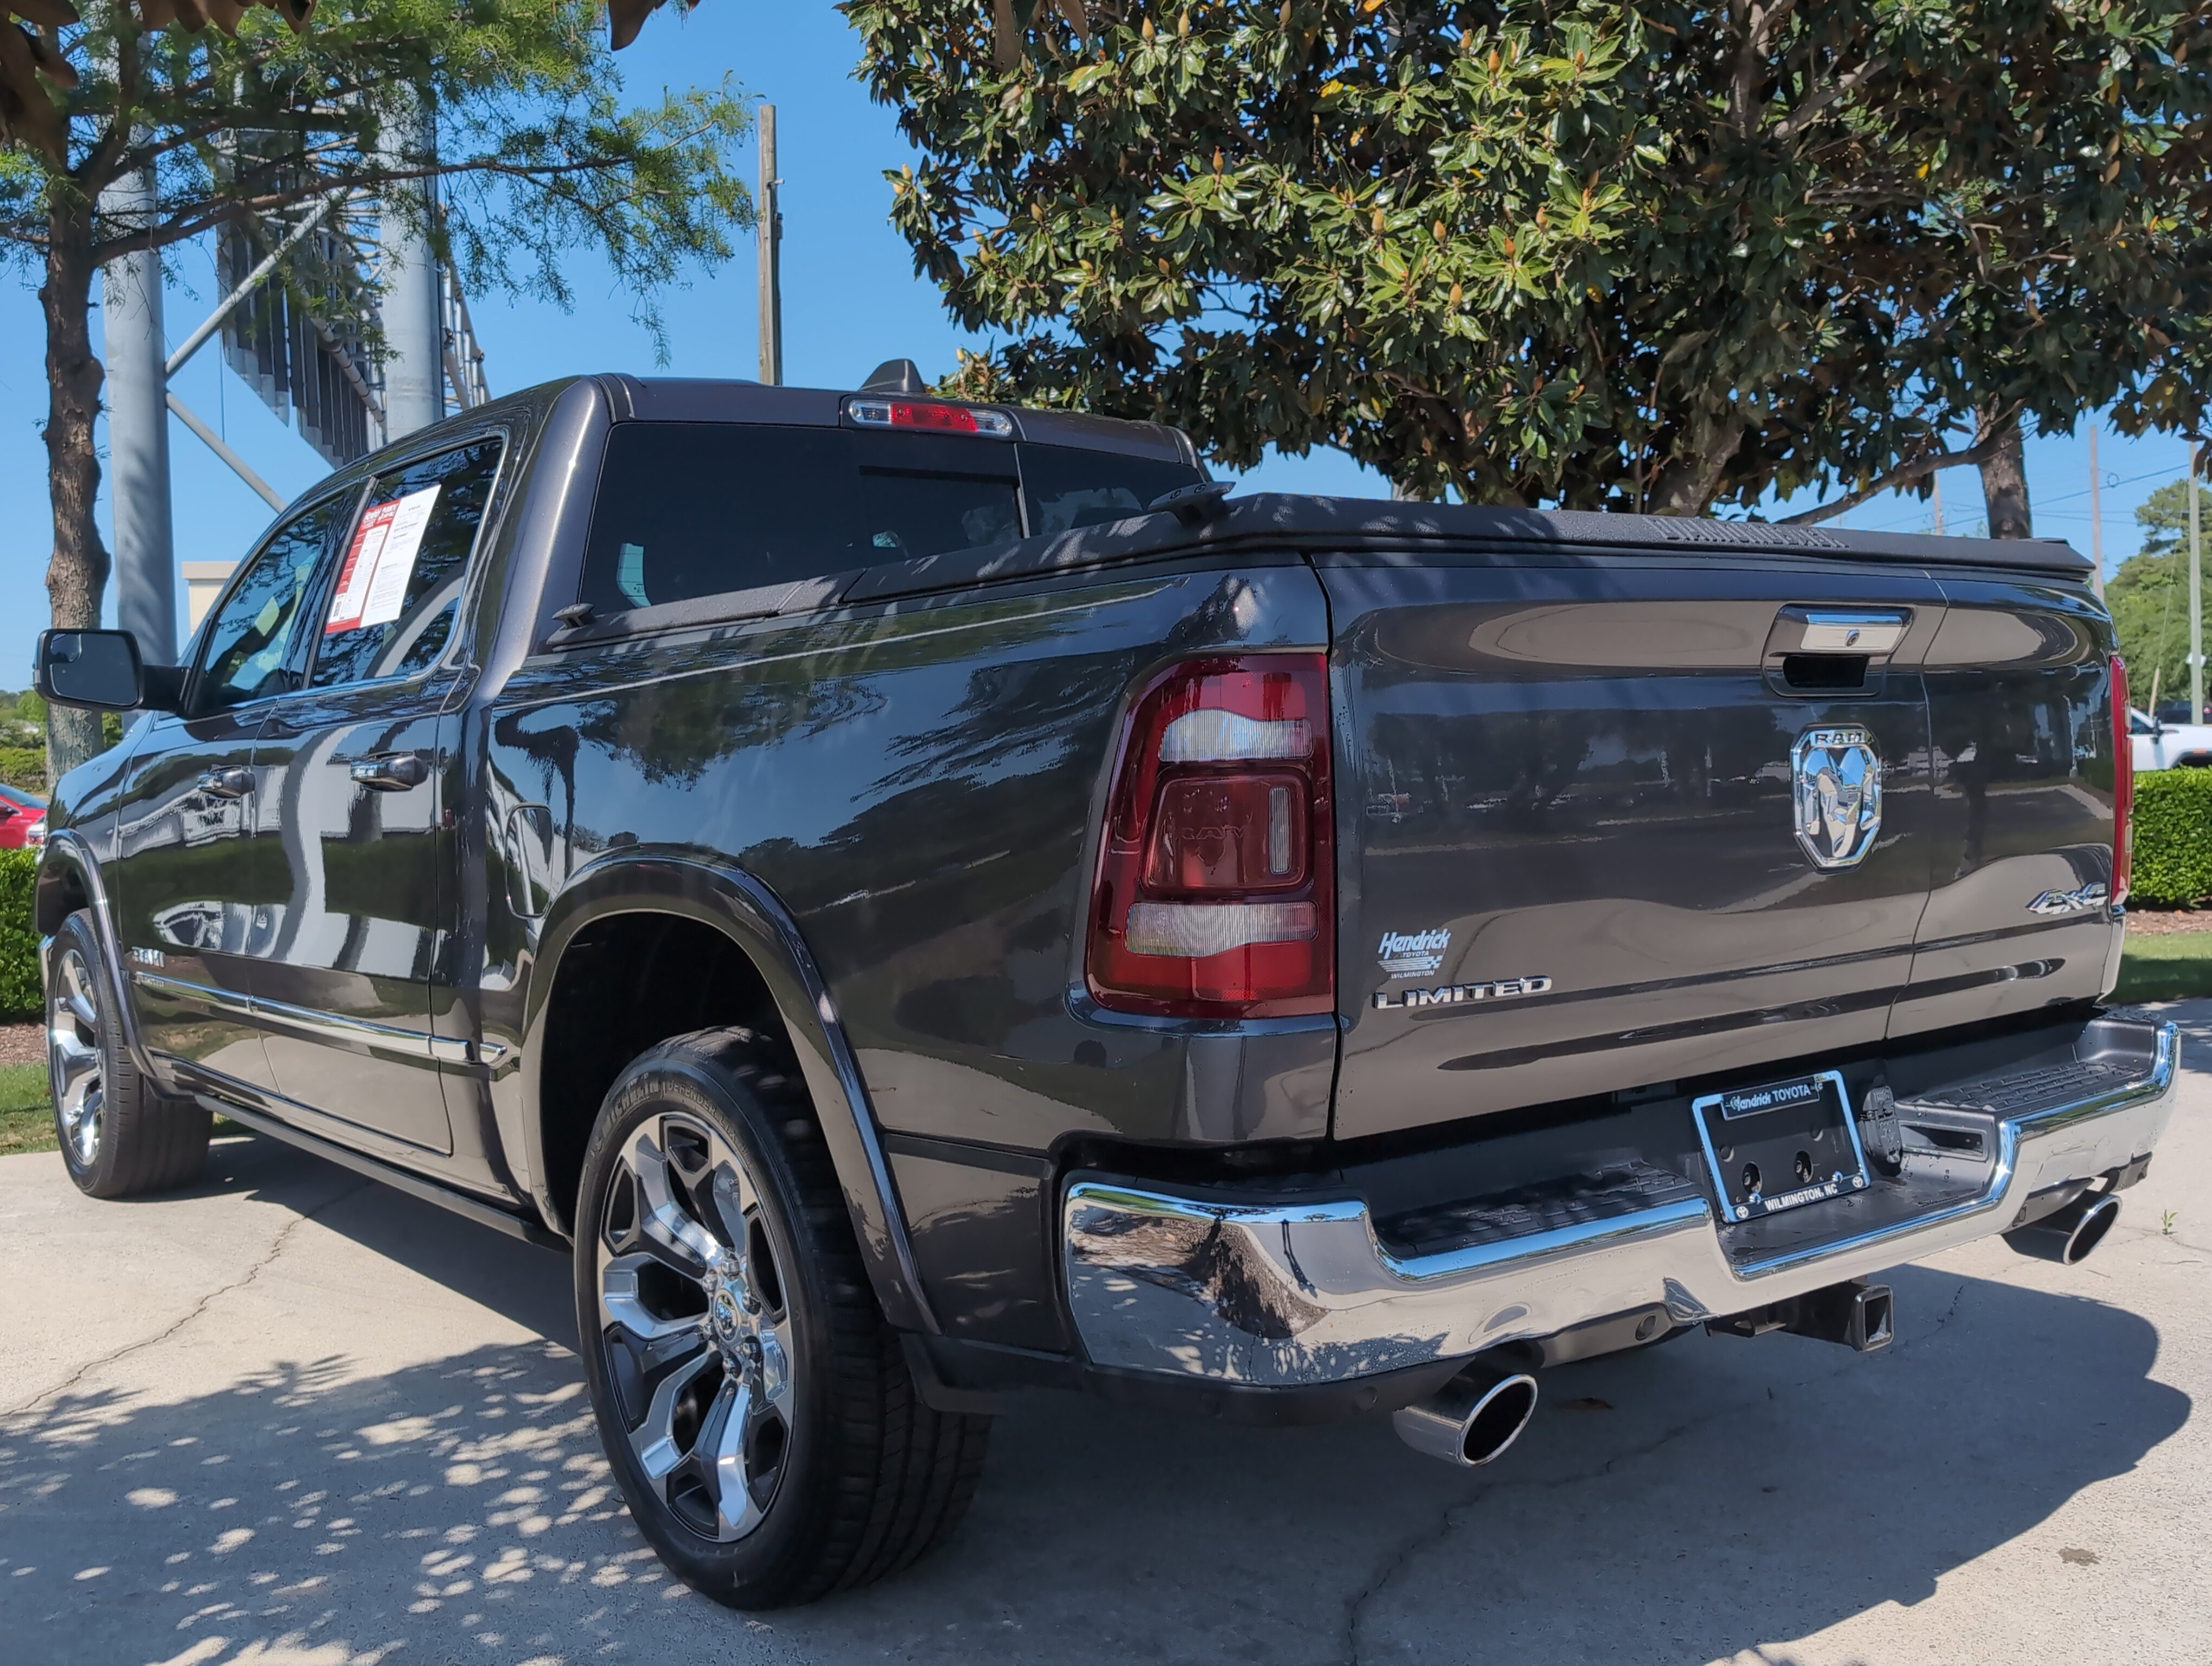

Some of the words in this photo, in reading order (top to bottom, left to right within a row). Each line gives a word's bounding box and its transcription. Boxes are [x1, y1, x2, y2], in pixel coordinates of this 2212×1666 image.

[1816, 731, 1866, 745] RAM
[1378, 928, 1451, 959] Hendrick
[1401, 950, 1430, 959] TOYOTA
[1391, 969, 1435, 979] WILMINGTON
[1373, 976, 1553, 1009] LIMITED
[667, 1079, 717, 1117] DEFENDER
[1730, 1091, 1771, 1112] Hendrick
[1772, 1084, 1811, 1100] TOYOTA
[1764, 1188, 1825, 1212] WILMINGTON,
[1824, 1183, 1838, 1195] NC
